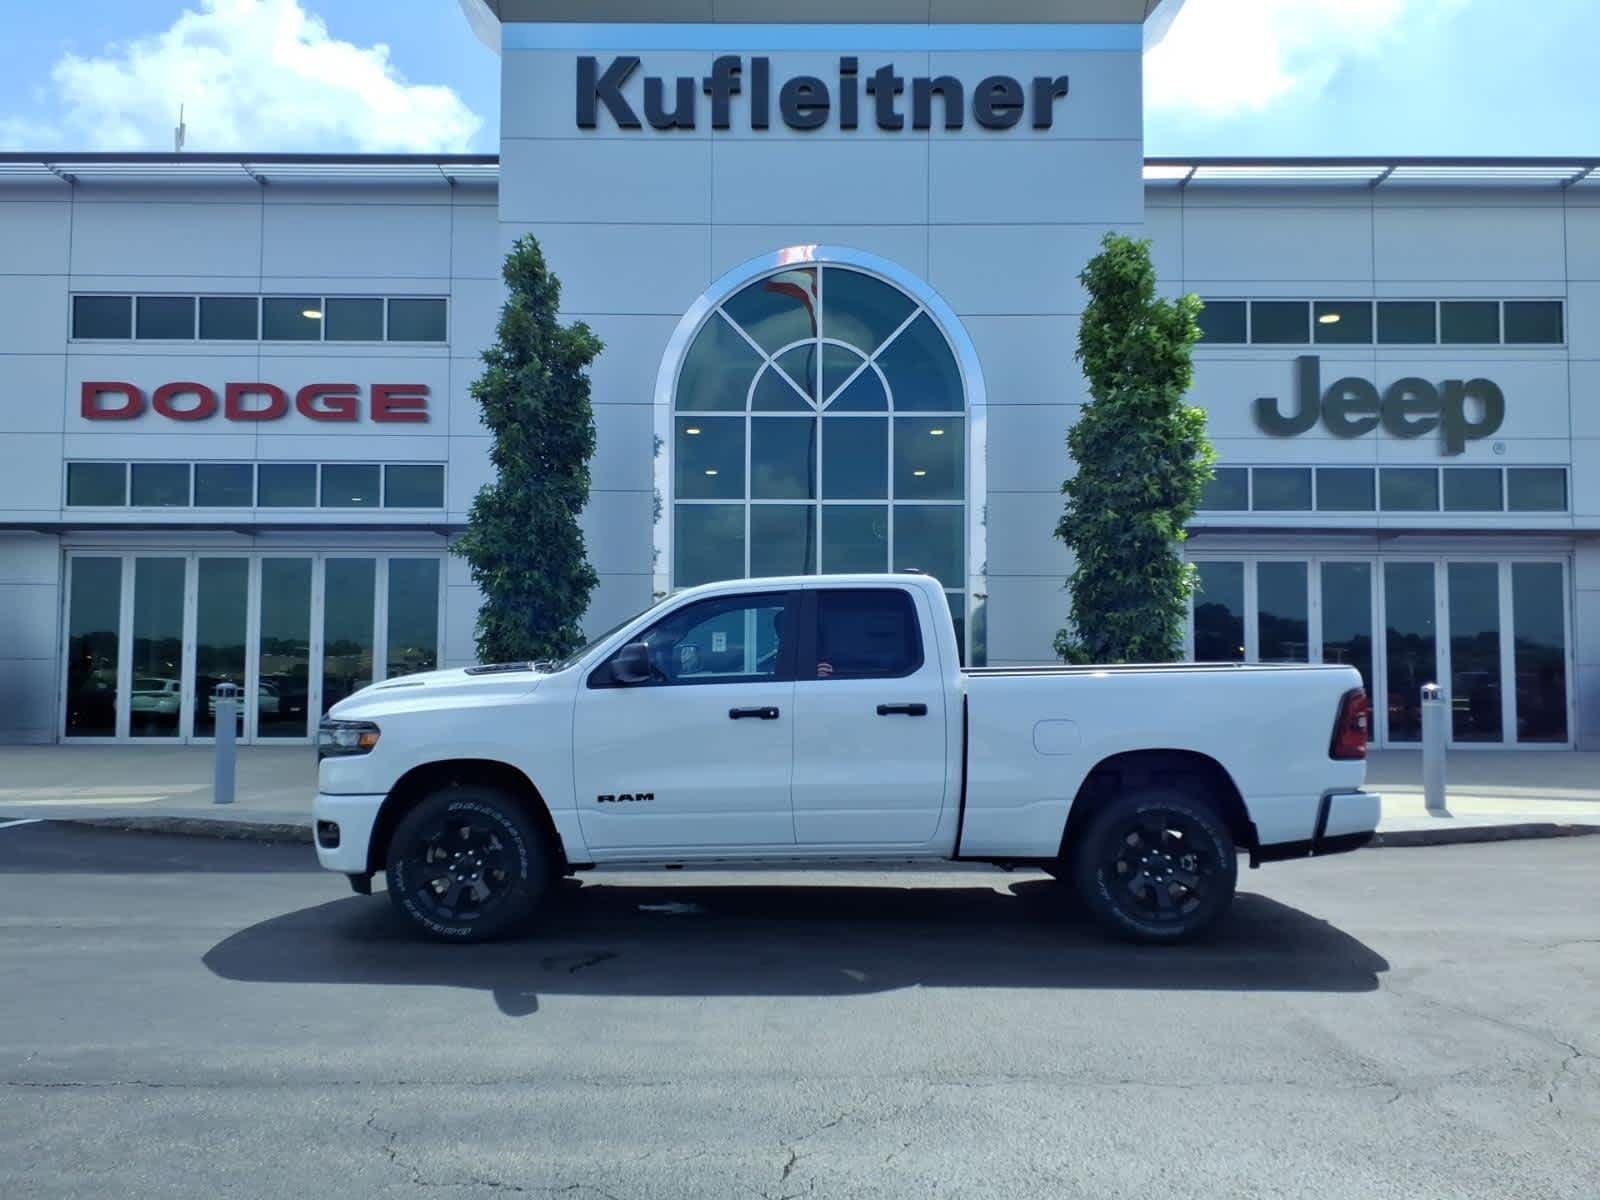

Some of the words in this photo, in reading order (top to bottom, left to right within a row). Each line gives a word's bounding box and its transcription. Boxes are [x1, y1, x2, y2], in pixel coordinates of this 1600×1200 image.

[576, 55, 1069, 130] Kufleitner
[81, 381, 430, 423] DODGE
[1253, 355, 1505, 457] Jeep
[597, 792, 655, 803] RAM
